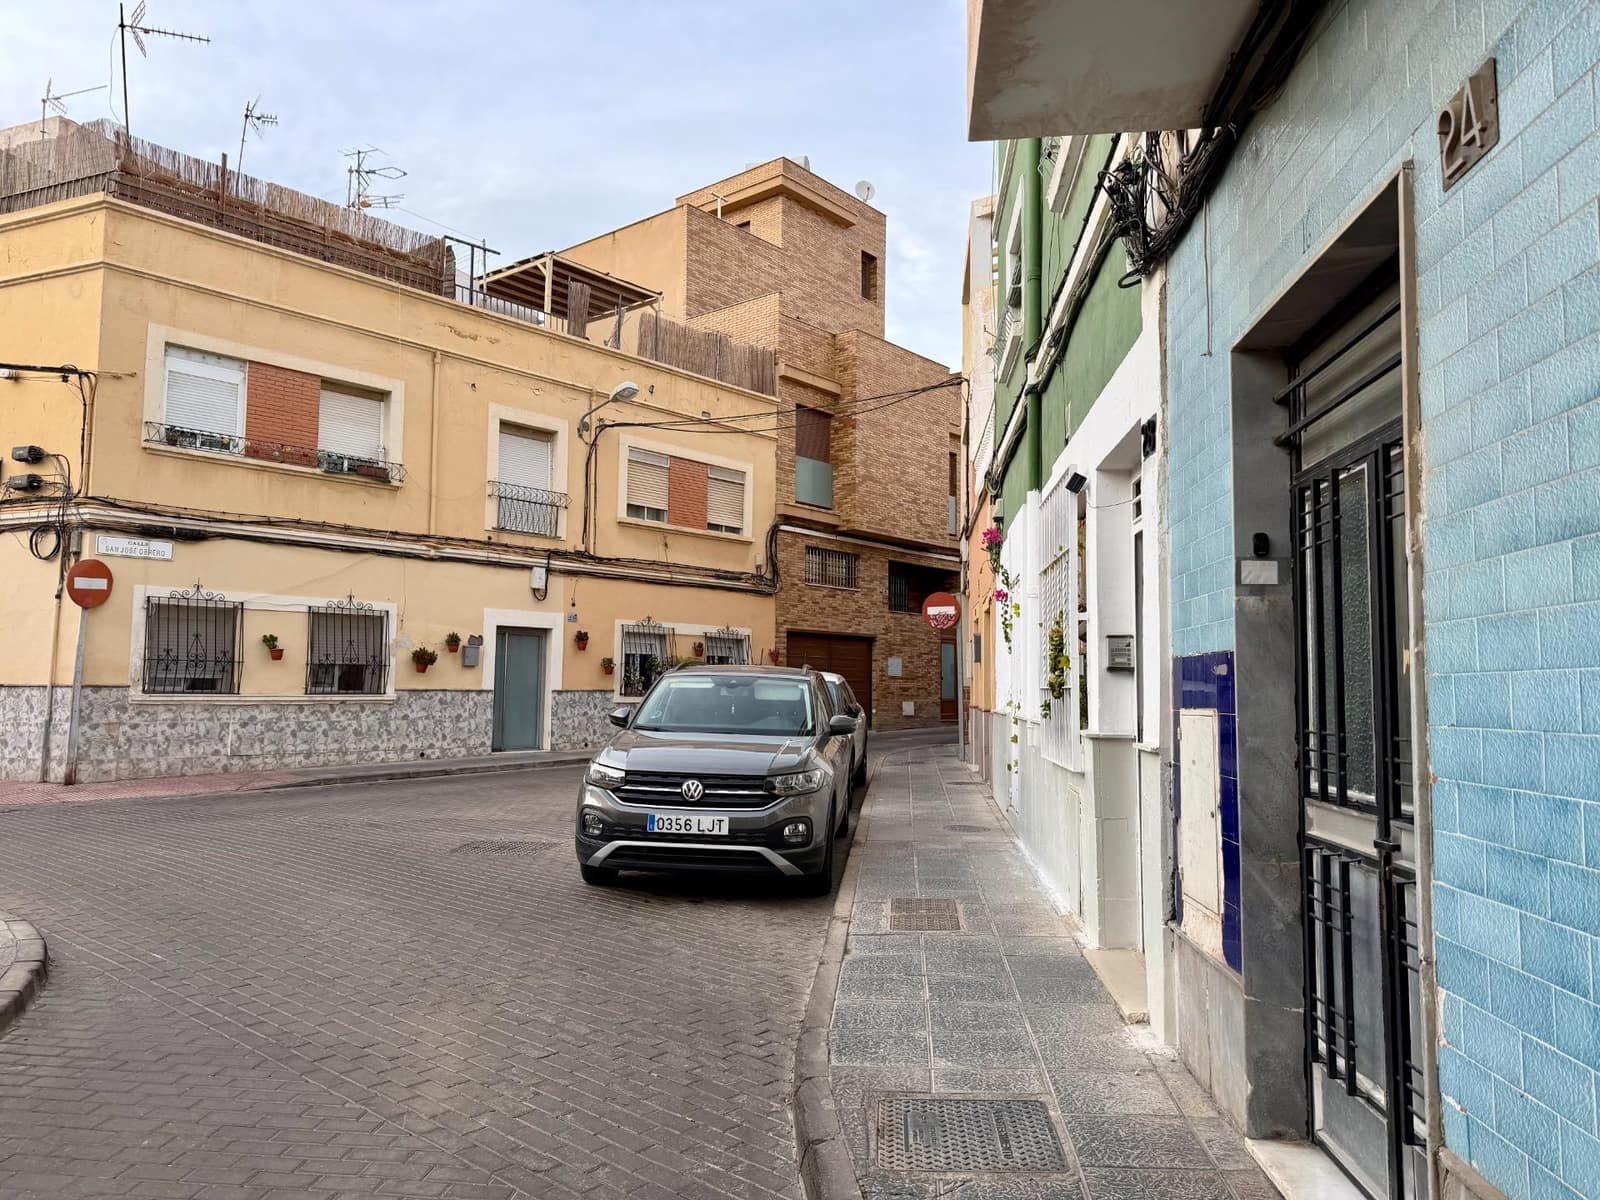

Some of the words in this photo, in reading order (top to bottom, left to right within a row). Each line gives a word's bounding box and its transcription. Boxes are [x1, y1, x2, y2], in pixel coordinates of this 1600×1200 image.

[1437, 79, 1482, 178] 24
[105, 545, 119, 553] SAN
[138, 548, 166, 557] OBRERO
[656, 817, 692, 832] 0356
[697, 818, 724, 833] LJT
